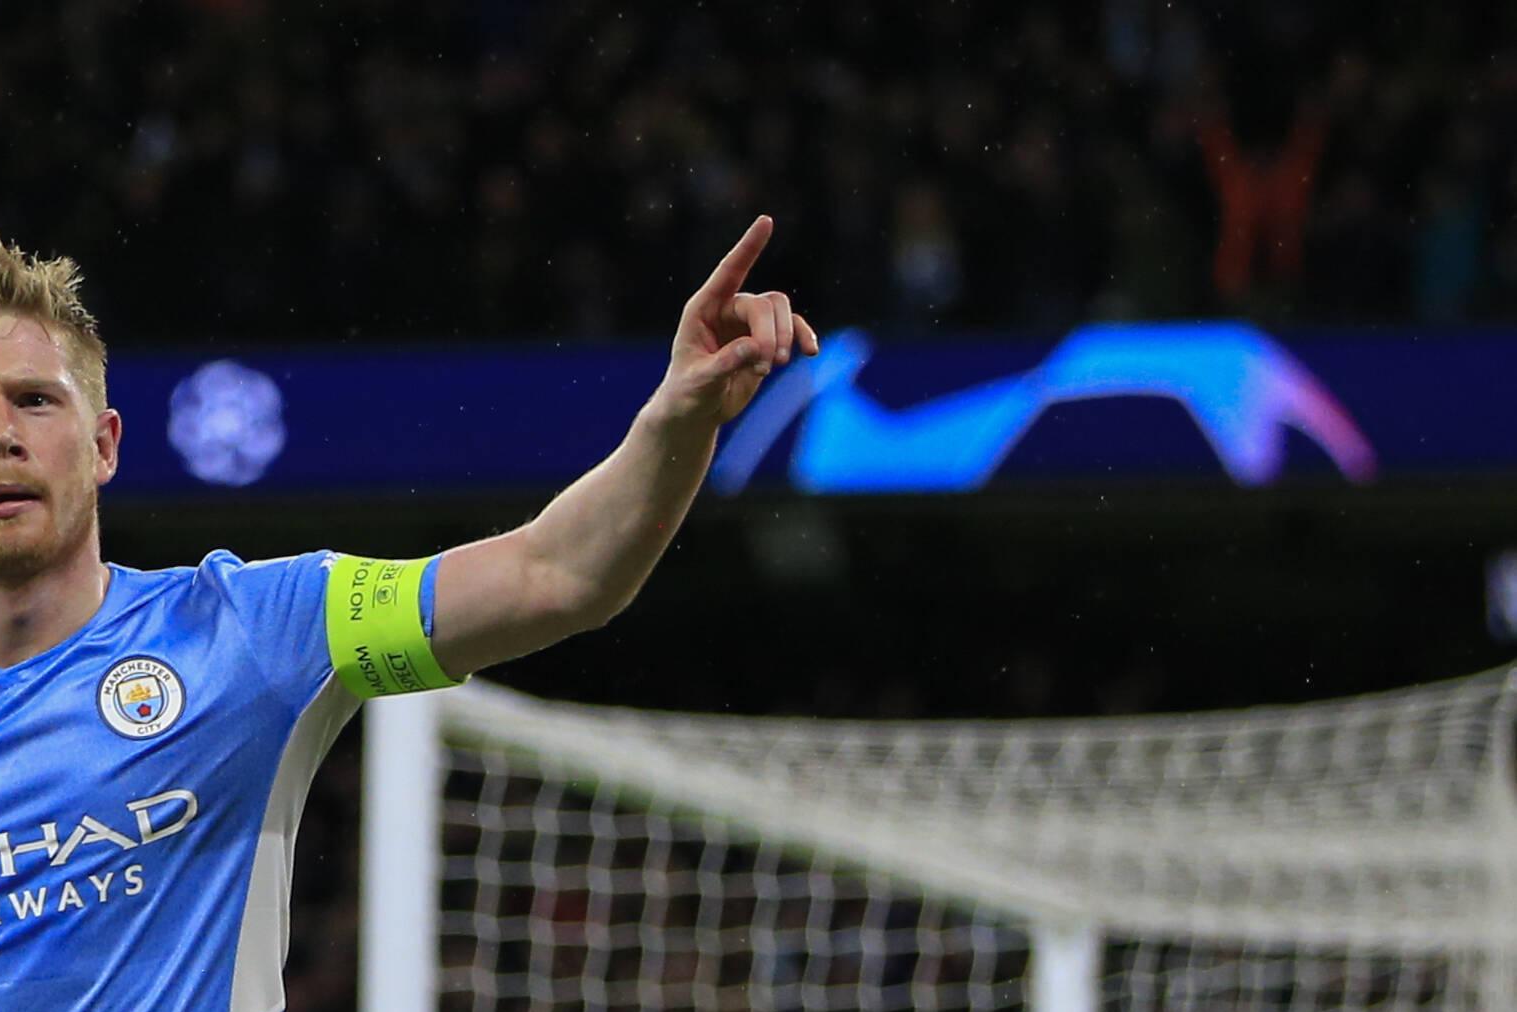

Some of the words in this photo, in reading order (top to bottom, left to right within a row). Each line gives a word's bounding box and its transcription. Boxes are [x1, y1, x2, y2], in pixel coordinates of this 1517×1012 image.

[352, 569, 368, 588] TO
[350, 592, 363, 621] NO
[104, 661, 171, 695] MANCHESTER
[136, 722, 162, 734] CITY
